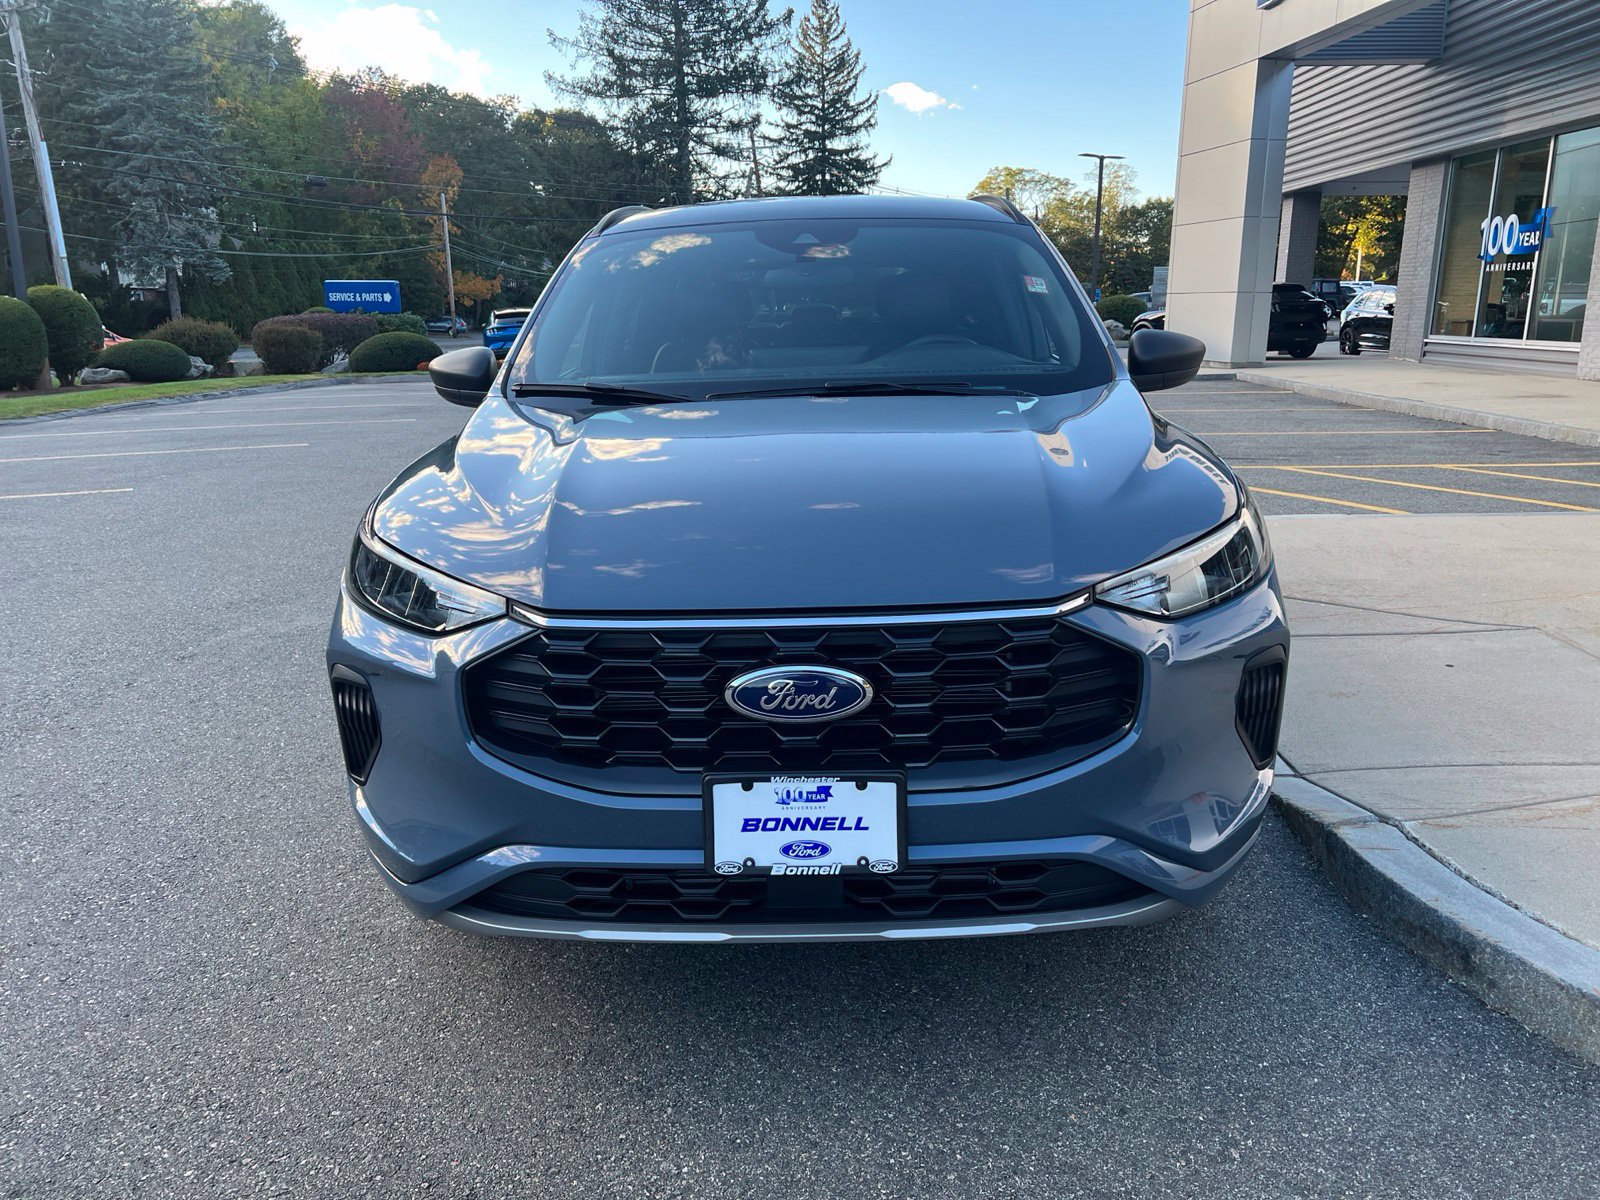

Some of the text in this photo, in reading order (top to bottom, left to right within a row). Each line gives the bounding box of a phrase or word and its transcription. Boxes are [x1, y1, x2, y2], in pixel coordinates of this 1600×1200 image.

[1480, 213, 1520, 256] 100
[328, 292, 383, 302] SERVICE & PARTS
[760, 679, 838, 710] Ford
[774, 786, 807, 804] 100
[741, 817, 869, 832] BONNELL
[789, 842, 822, 857] Ford
[718, 863, 741, 873] Ford
[770, 863, 842, 875] Bonnell
[873, 862, 894, 872] Ford
